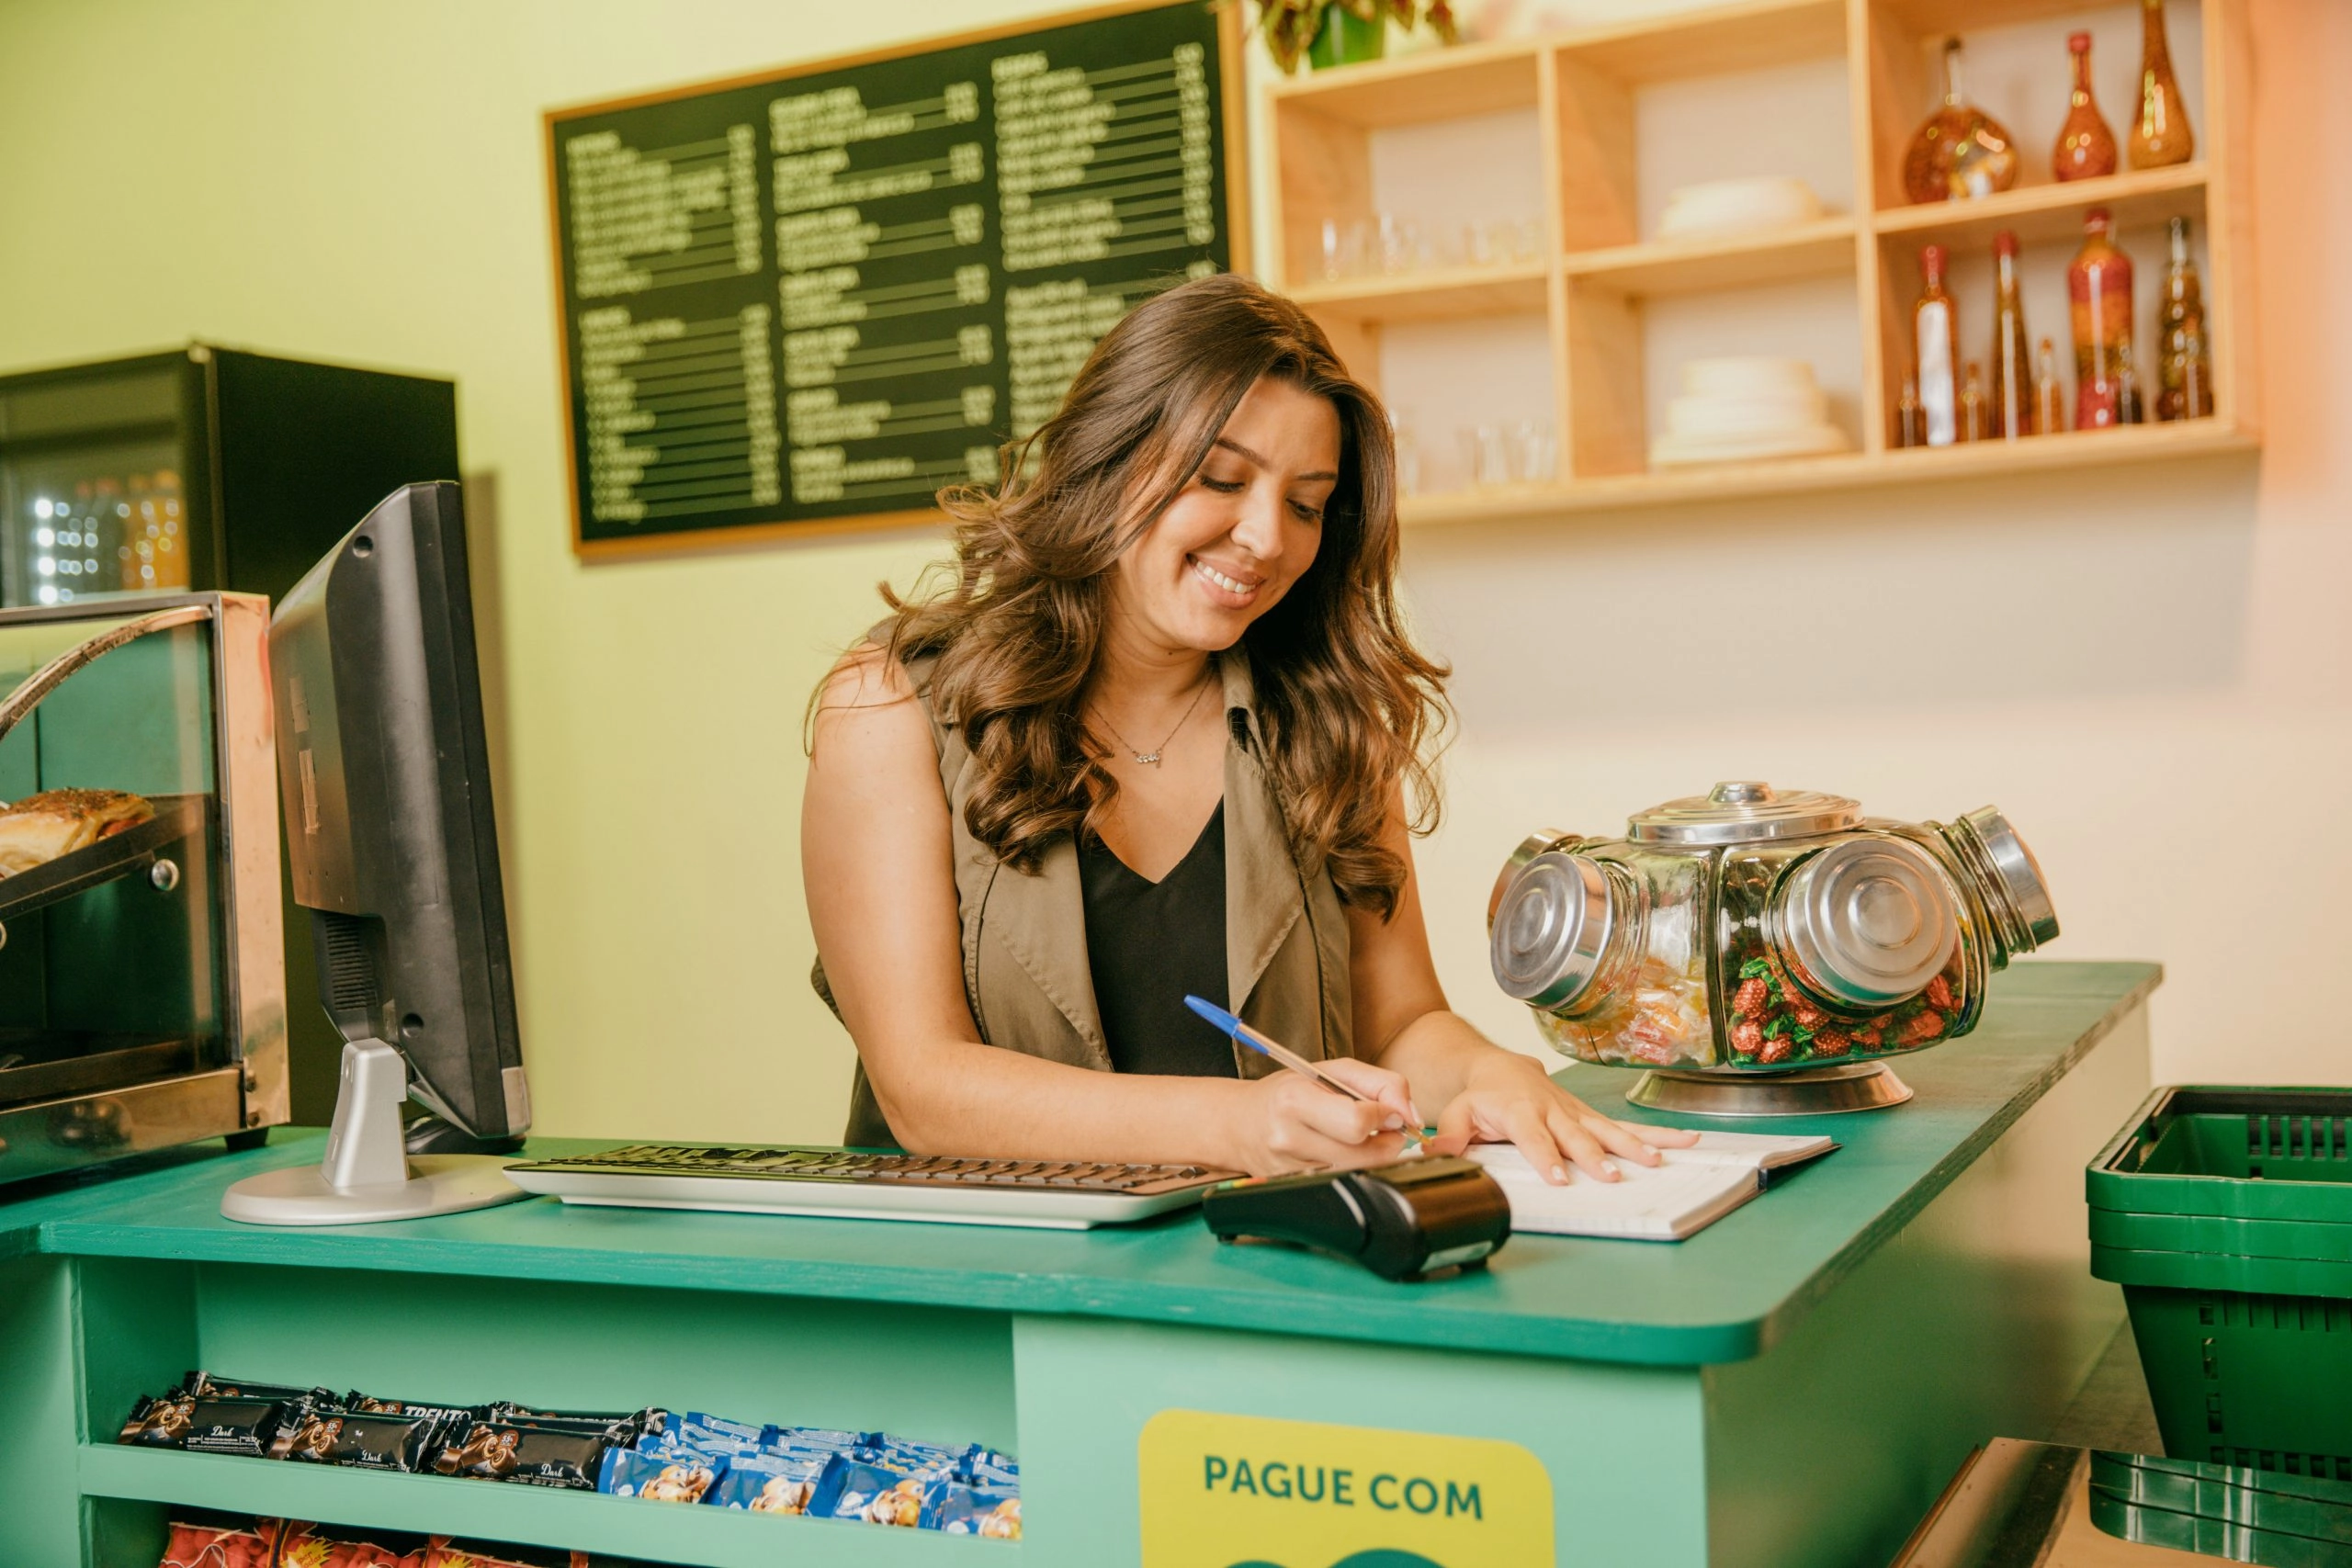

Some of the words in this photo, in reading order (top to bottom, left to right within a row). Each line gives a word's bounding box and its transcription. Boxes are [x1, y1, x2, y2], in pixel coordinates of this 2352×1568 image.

[210, 1426, 234, 1437] Dark
[361, 1450, 382, 1462] Dark
[540, 1463, 563, 1478] Dark
[1204, 1455, 1354, 1506] PAGUE
[1369, 1473, 1484, 1521] COM
